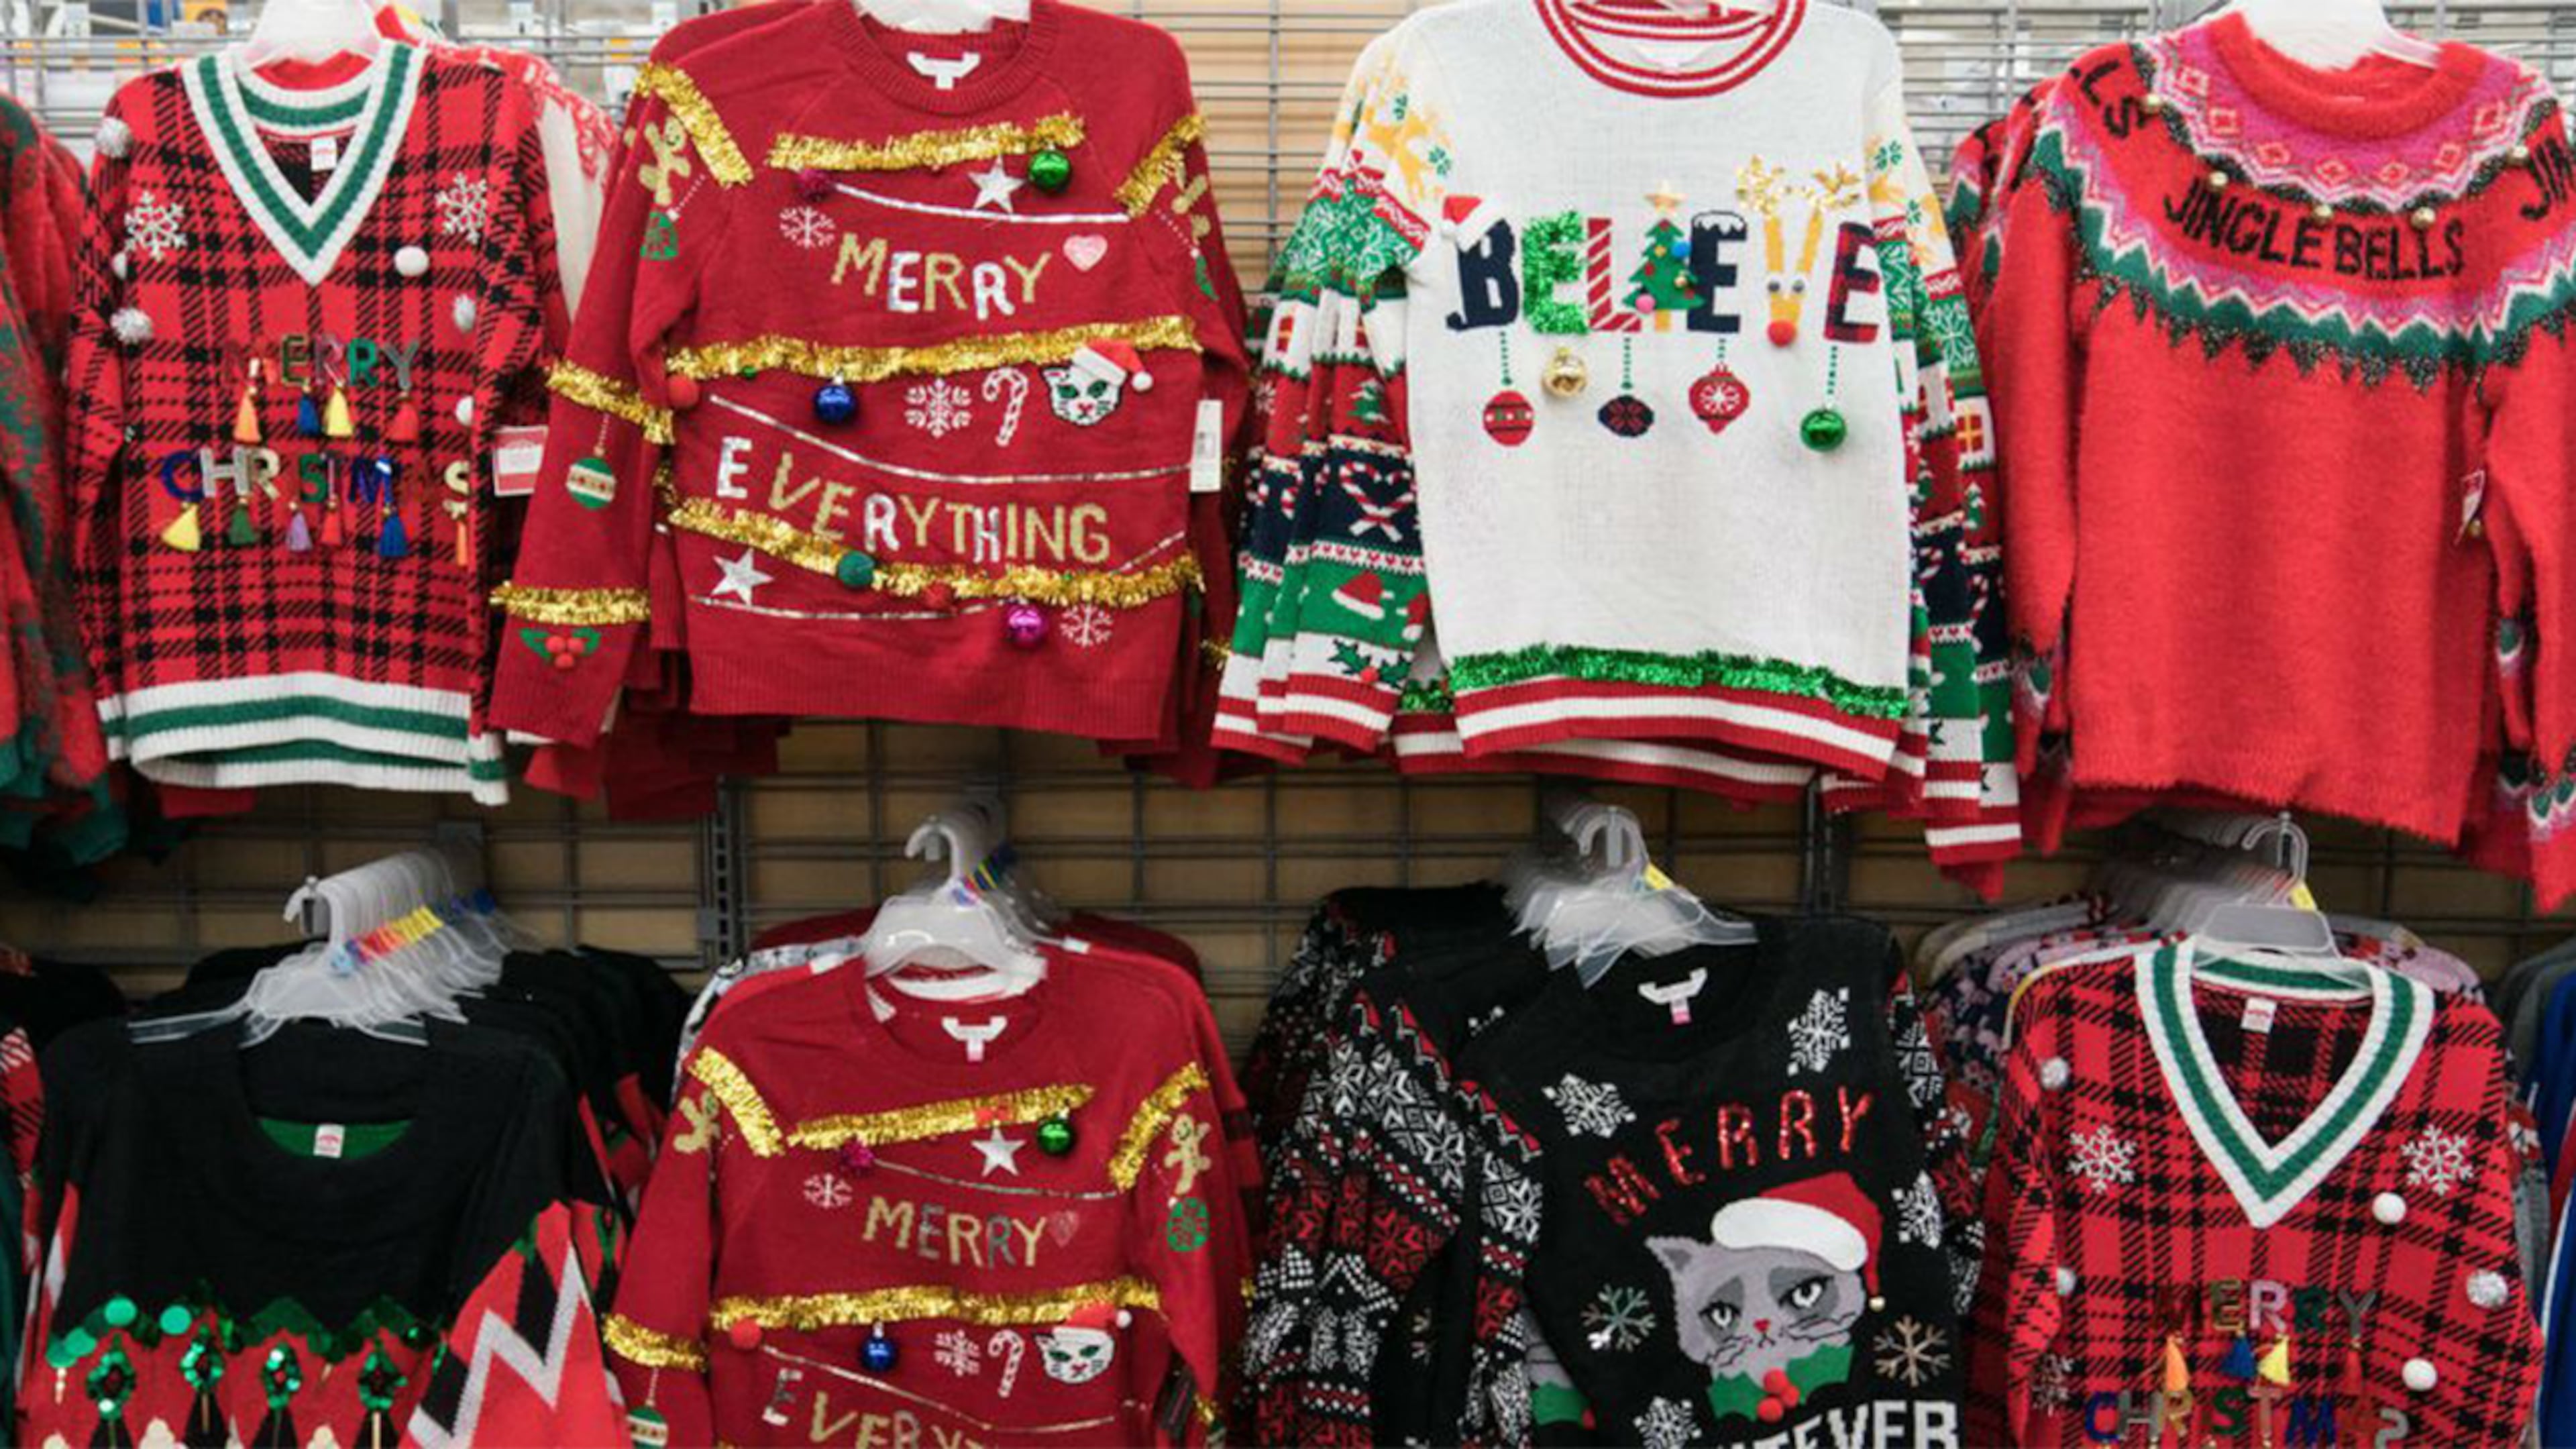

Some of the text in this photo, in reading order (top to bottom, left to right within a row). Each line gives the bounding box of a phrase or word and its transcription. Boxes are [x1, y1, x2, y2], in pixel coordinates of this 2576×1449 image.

[2162, 177, 2465, 280] JINGLE BELLS
[831, 233, 1052, 321] MERRY
[716, 435, 1110, 562] EVERYTHING
[1585, 1085, 1873, 1226] MERRY
[862, 1196, 1047, 1269] MERRY
[762, 1367, 986, 1449] EVERY
